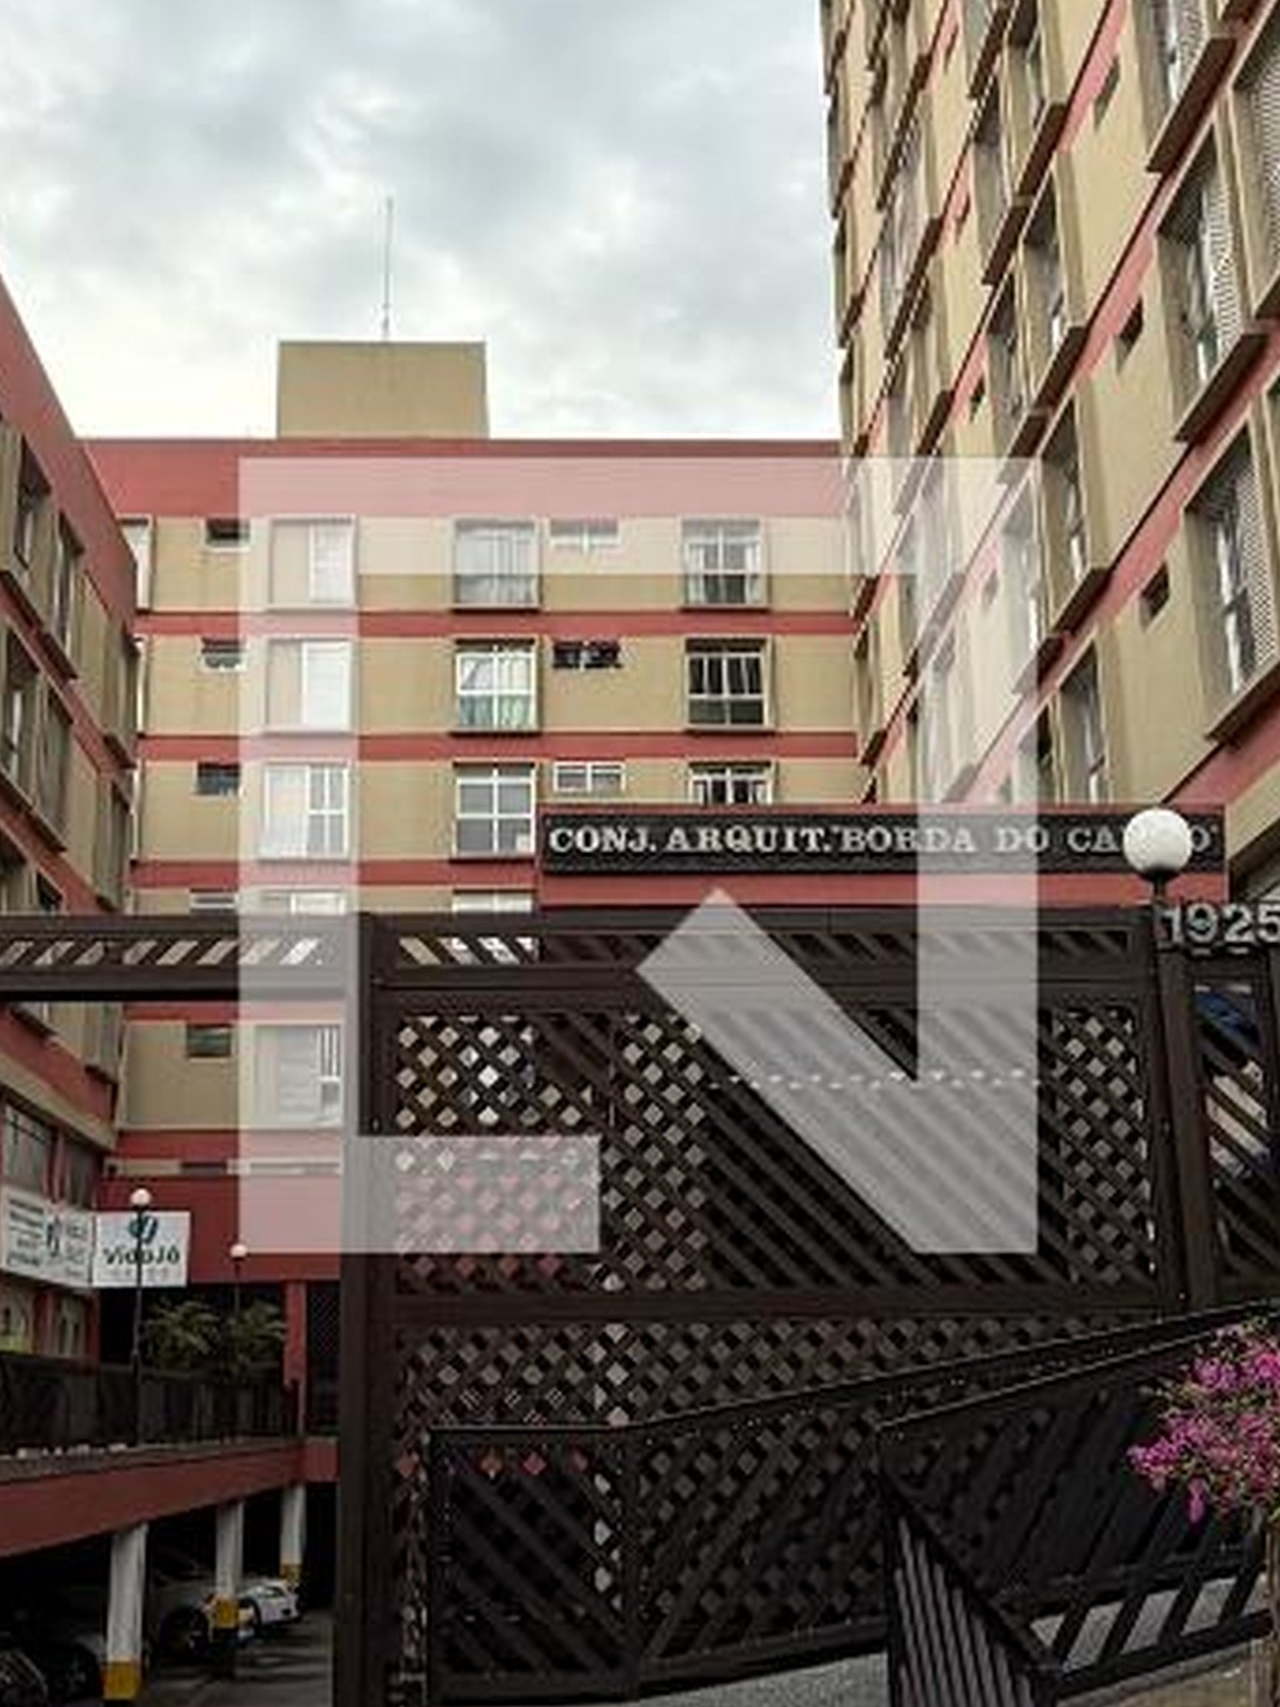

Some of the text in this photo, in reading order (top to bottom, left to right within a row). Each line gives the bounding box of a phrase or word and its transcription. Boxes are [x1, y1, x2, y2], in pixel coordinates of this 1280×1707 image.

[549, 824, 658, 853] CONJ.
[665, 824, 831, 854] ARQUIT.
[994, 824, 1050, 854] DO
